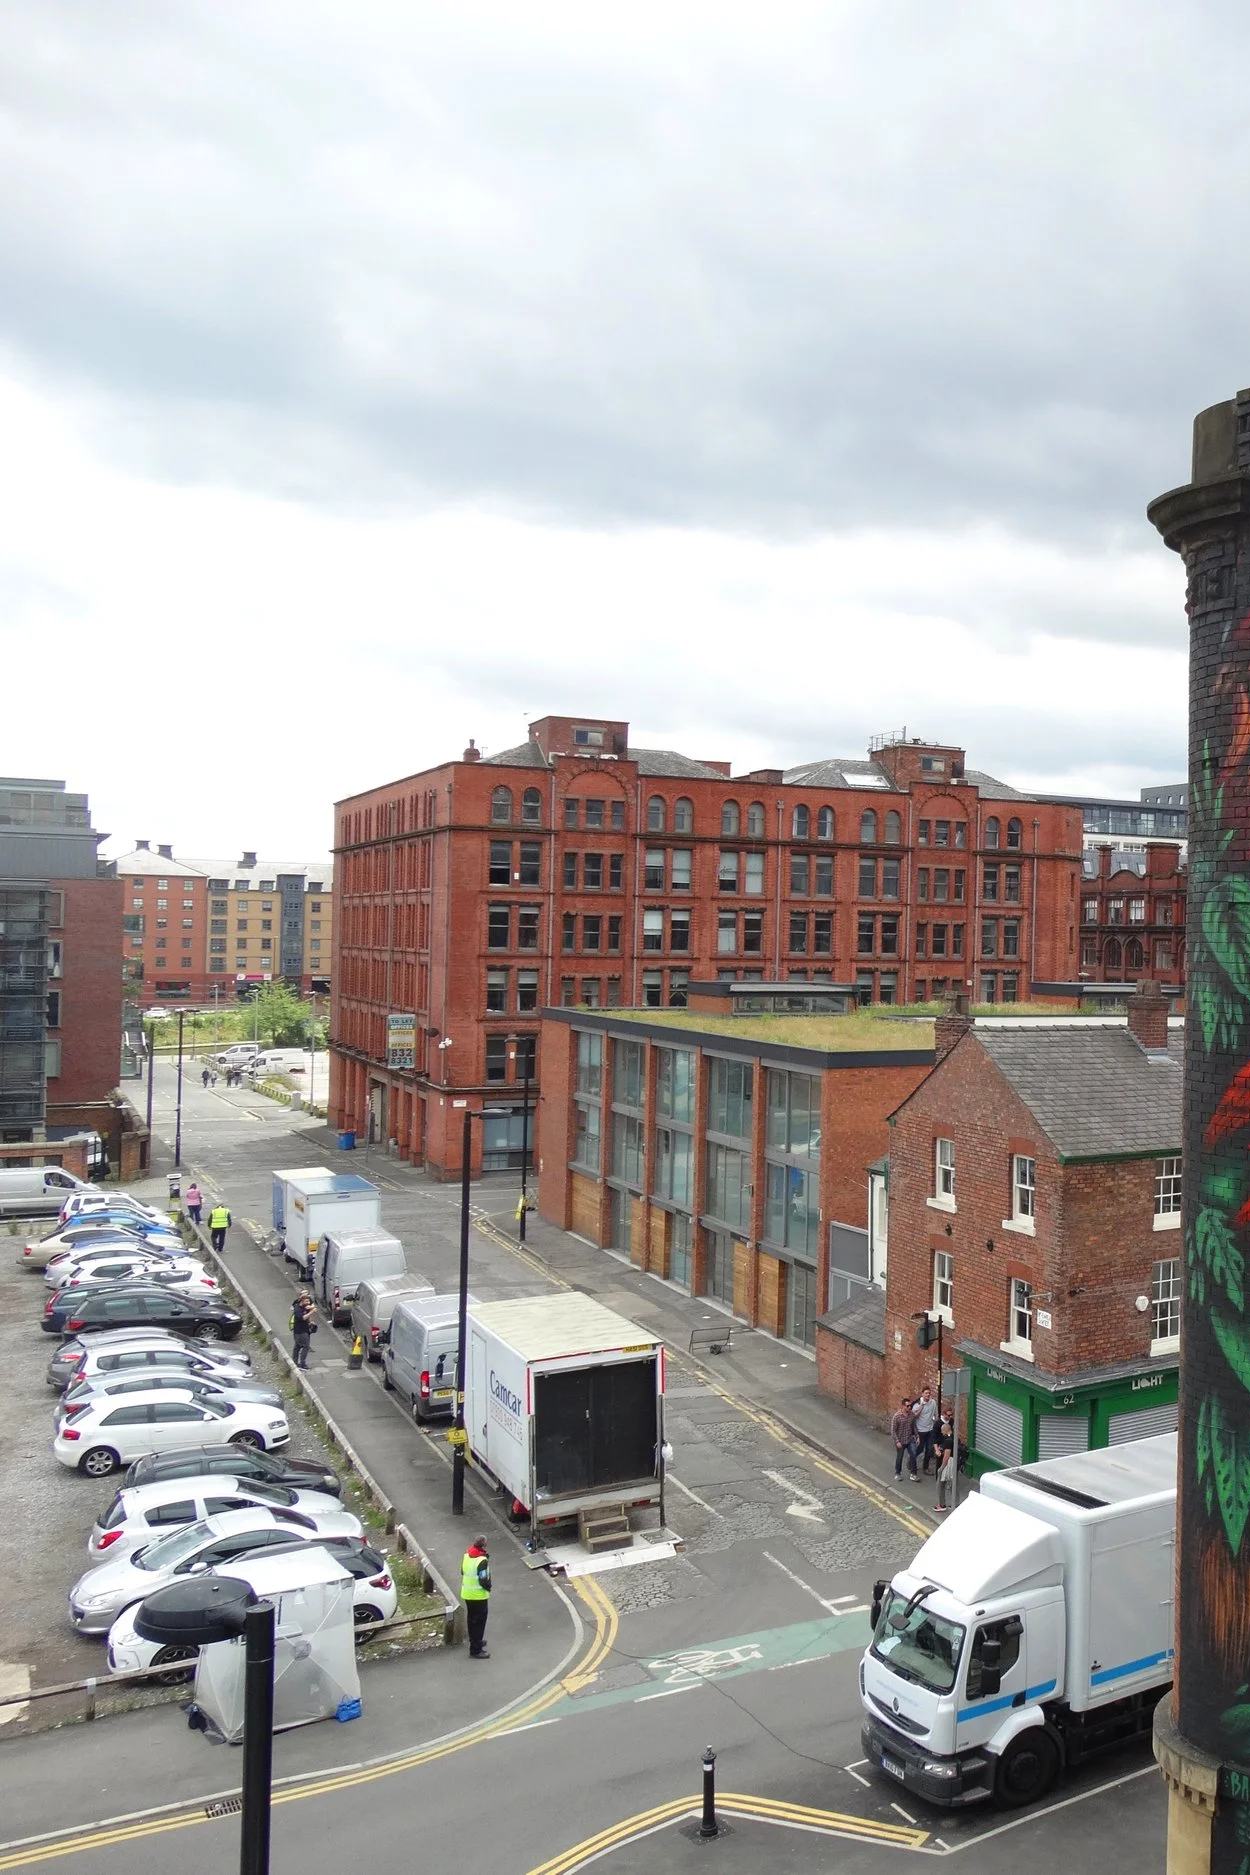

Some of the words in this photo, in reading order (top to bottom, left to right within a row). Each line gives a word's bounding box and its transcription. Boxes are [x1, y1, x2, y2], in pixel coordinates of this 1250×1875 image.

[391, 1048, 413, 1057] 832
[490, 1369, 522, 1417] Camcar
[1063, 1393, 1074, 1404] 62
